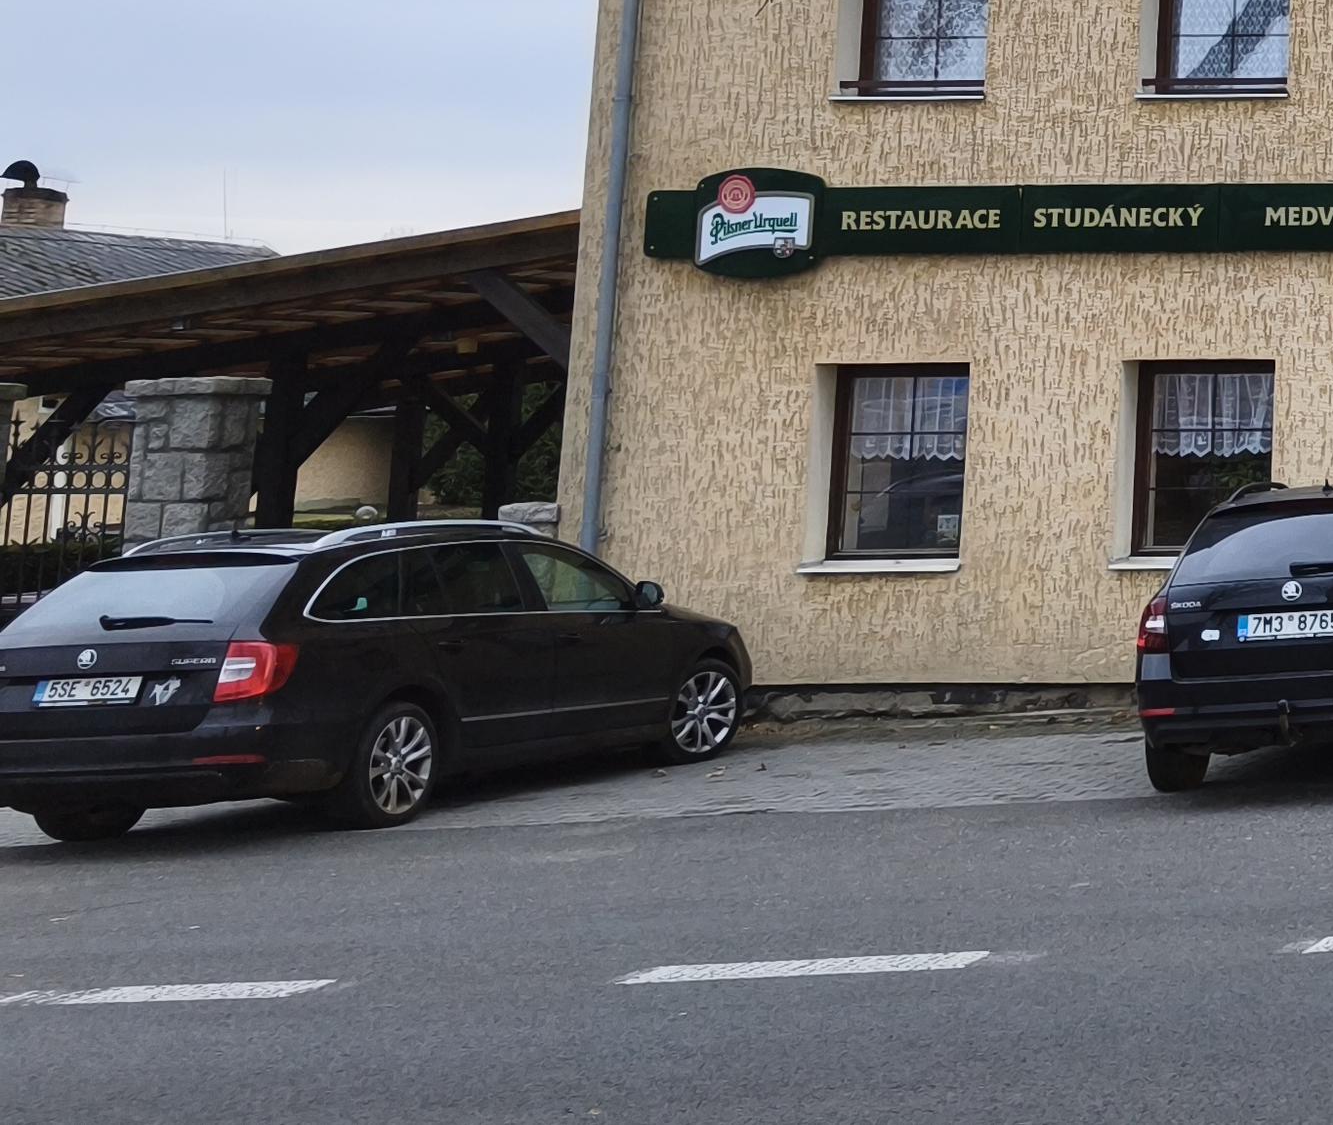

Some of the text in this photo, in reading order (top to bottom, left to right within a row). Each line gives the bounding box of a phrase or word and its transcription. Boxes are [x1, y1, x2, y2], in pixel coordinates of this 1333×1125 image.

[710, 211, 798, 245] Pilsner Urquell
[841, 209, 1001, 230] RESTAURACE
[1033, 203, 1204, 228] STUDÁNECKÝ
[1252, 615, 1284, 634] 7M3
[48, 678, 131, 698] 5SE 6524
